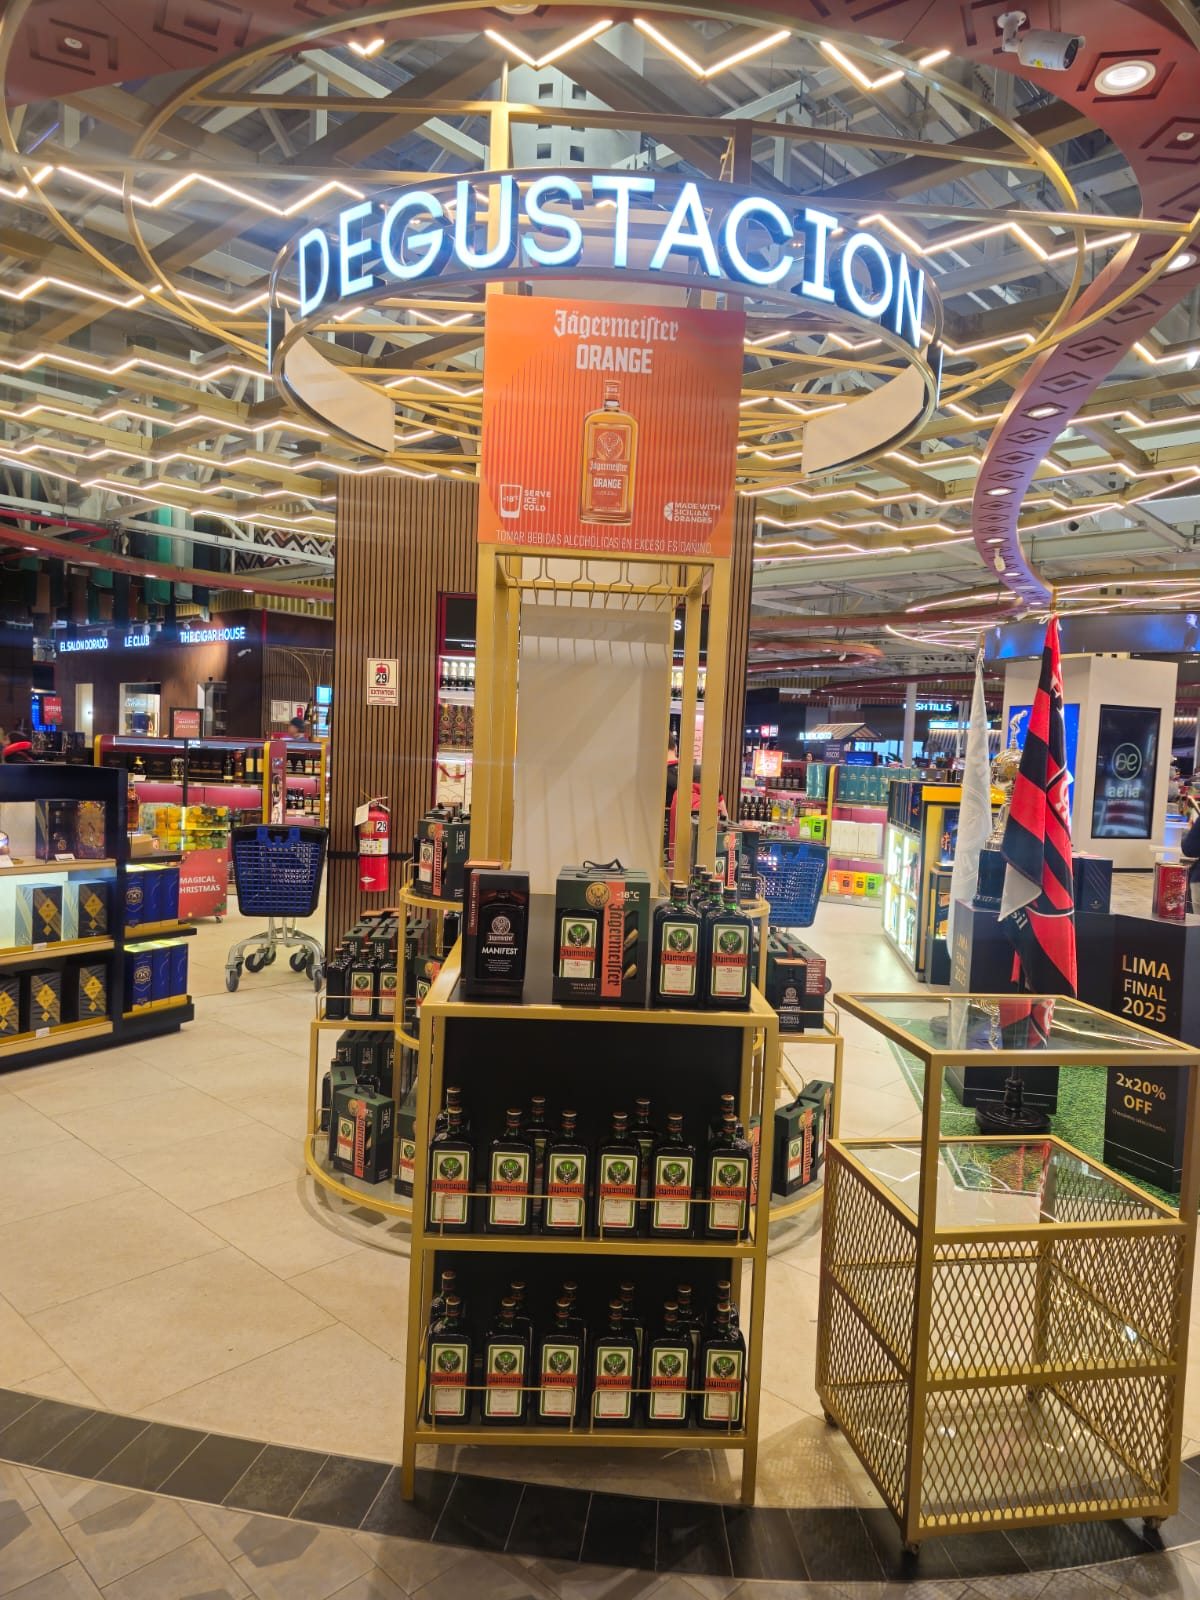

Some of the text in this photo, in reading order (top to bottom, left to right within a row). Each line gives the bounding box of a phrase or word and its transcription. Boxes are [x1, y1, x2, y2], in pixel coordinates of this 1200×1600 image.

[299, 174, 926, 349] DEGUSTACION
[576, 343, 653, 374] ORANGE
[593, 478, 622, 489] ORANGE
[523, 489, 552, 498] SERVE
[523, 504, 546, 512] COLD
[673, 509, 709, 517] SICILIAN
[674, 502, 720, 511] MADE WITH
[673, 515, 713, 524] ORANGES
[496, 530, 525, 542] TOMAR
[527, 531, 562, 545] BEBIDAS
[621, 539, 633, 550] EN
[634, 538, 665, 552] EXCESO
[667, 541, 678, 552] ES
[124, 634, 150, 647] LE CLUB
[194, 629, 218, 643] CIGAR
[218, 627, 245, 641] HOUSE
[60, 638, 108, 652] EL SALON DORADO
[375, 673, 388, 684] 29
[929, 703, 953, 712] TILLS
[1108, 784, 1140, 798] aelia
[180, 876, 216, 884] MAGICAL
[179, 885, 221, 894] HRISTMAS
[481, 946, 519, 955] MANIFEST
[1121, 954, 1172, 982] LIMA
[1123, 978, 1168, 1003] FINAL
[1121, 997, 1168, 1023] 2025
[1115, 1072, 1167, 1101] 2x20%
[1123, 1095, 1153, 1115] OFF
